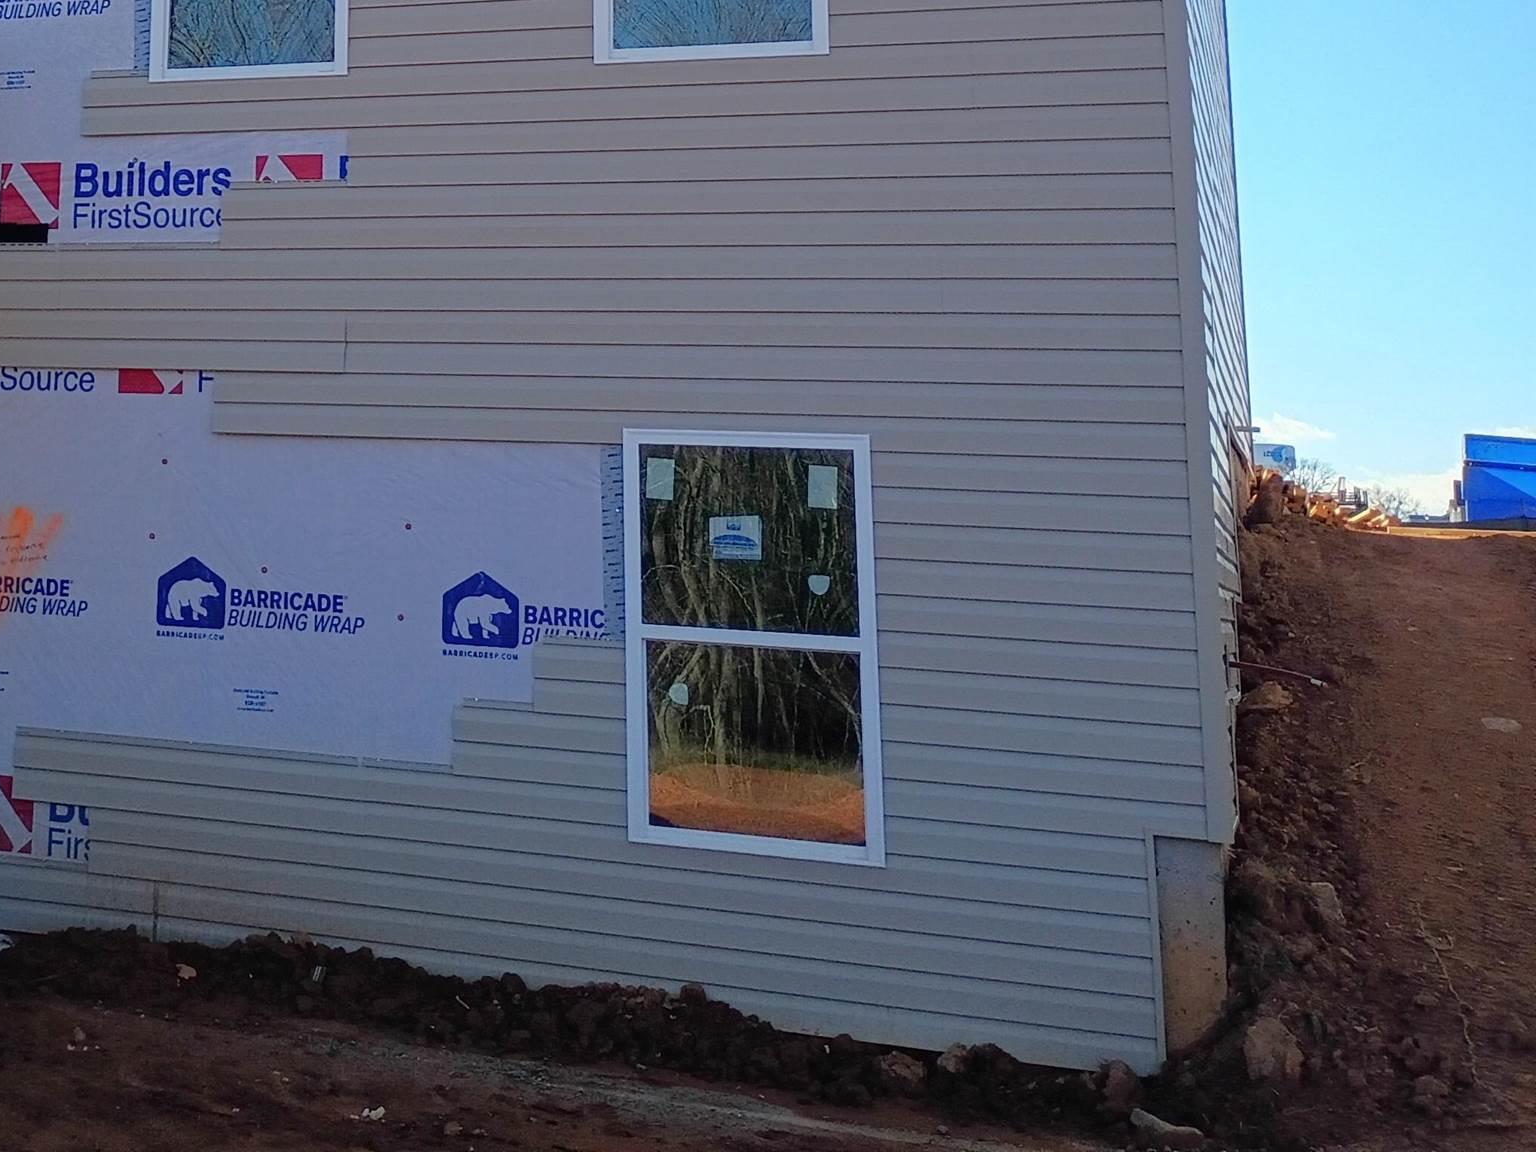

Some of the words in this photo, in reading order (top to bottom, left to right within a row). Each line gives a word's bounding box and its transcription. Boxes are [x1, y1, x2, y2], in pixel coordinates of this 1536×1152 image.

[66, 0, 111, 16] WRAP
[74, 160, 232, 198] Builders
[42, 598, 88, 617] WRAP
[230, 588, 345, 614] BARRICADE
[227, 609, 309, 631] BUILDING
[314, 614, 365, 635] WRAP
